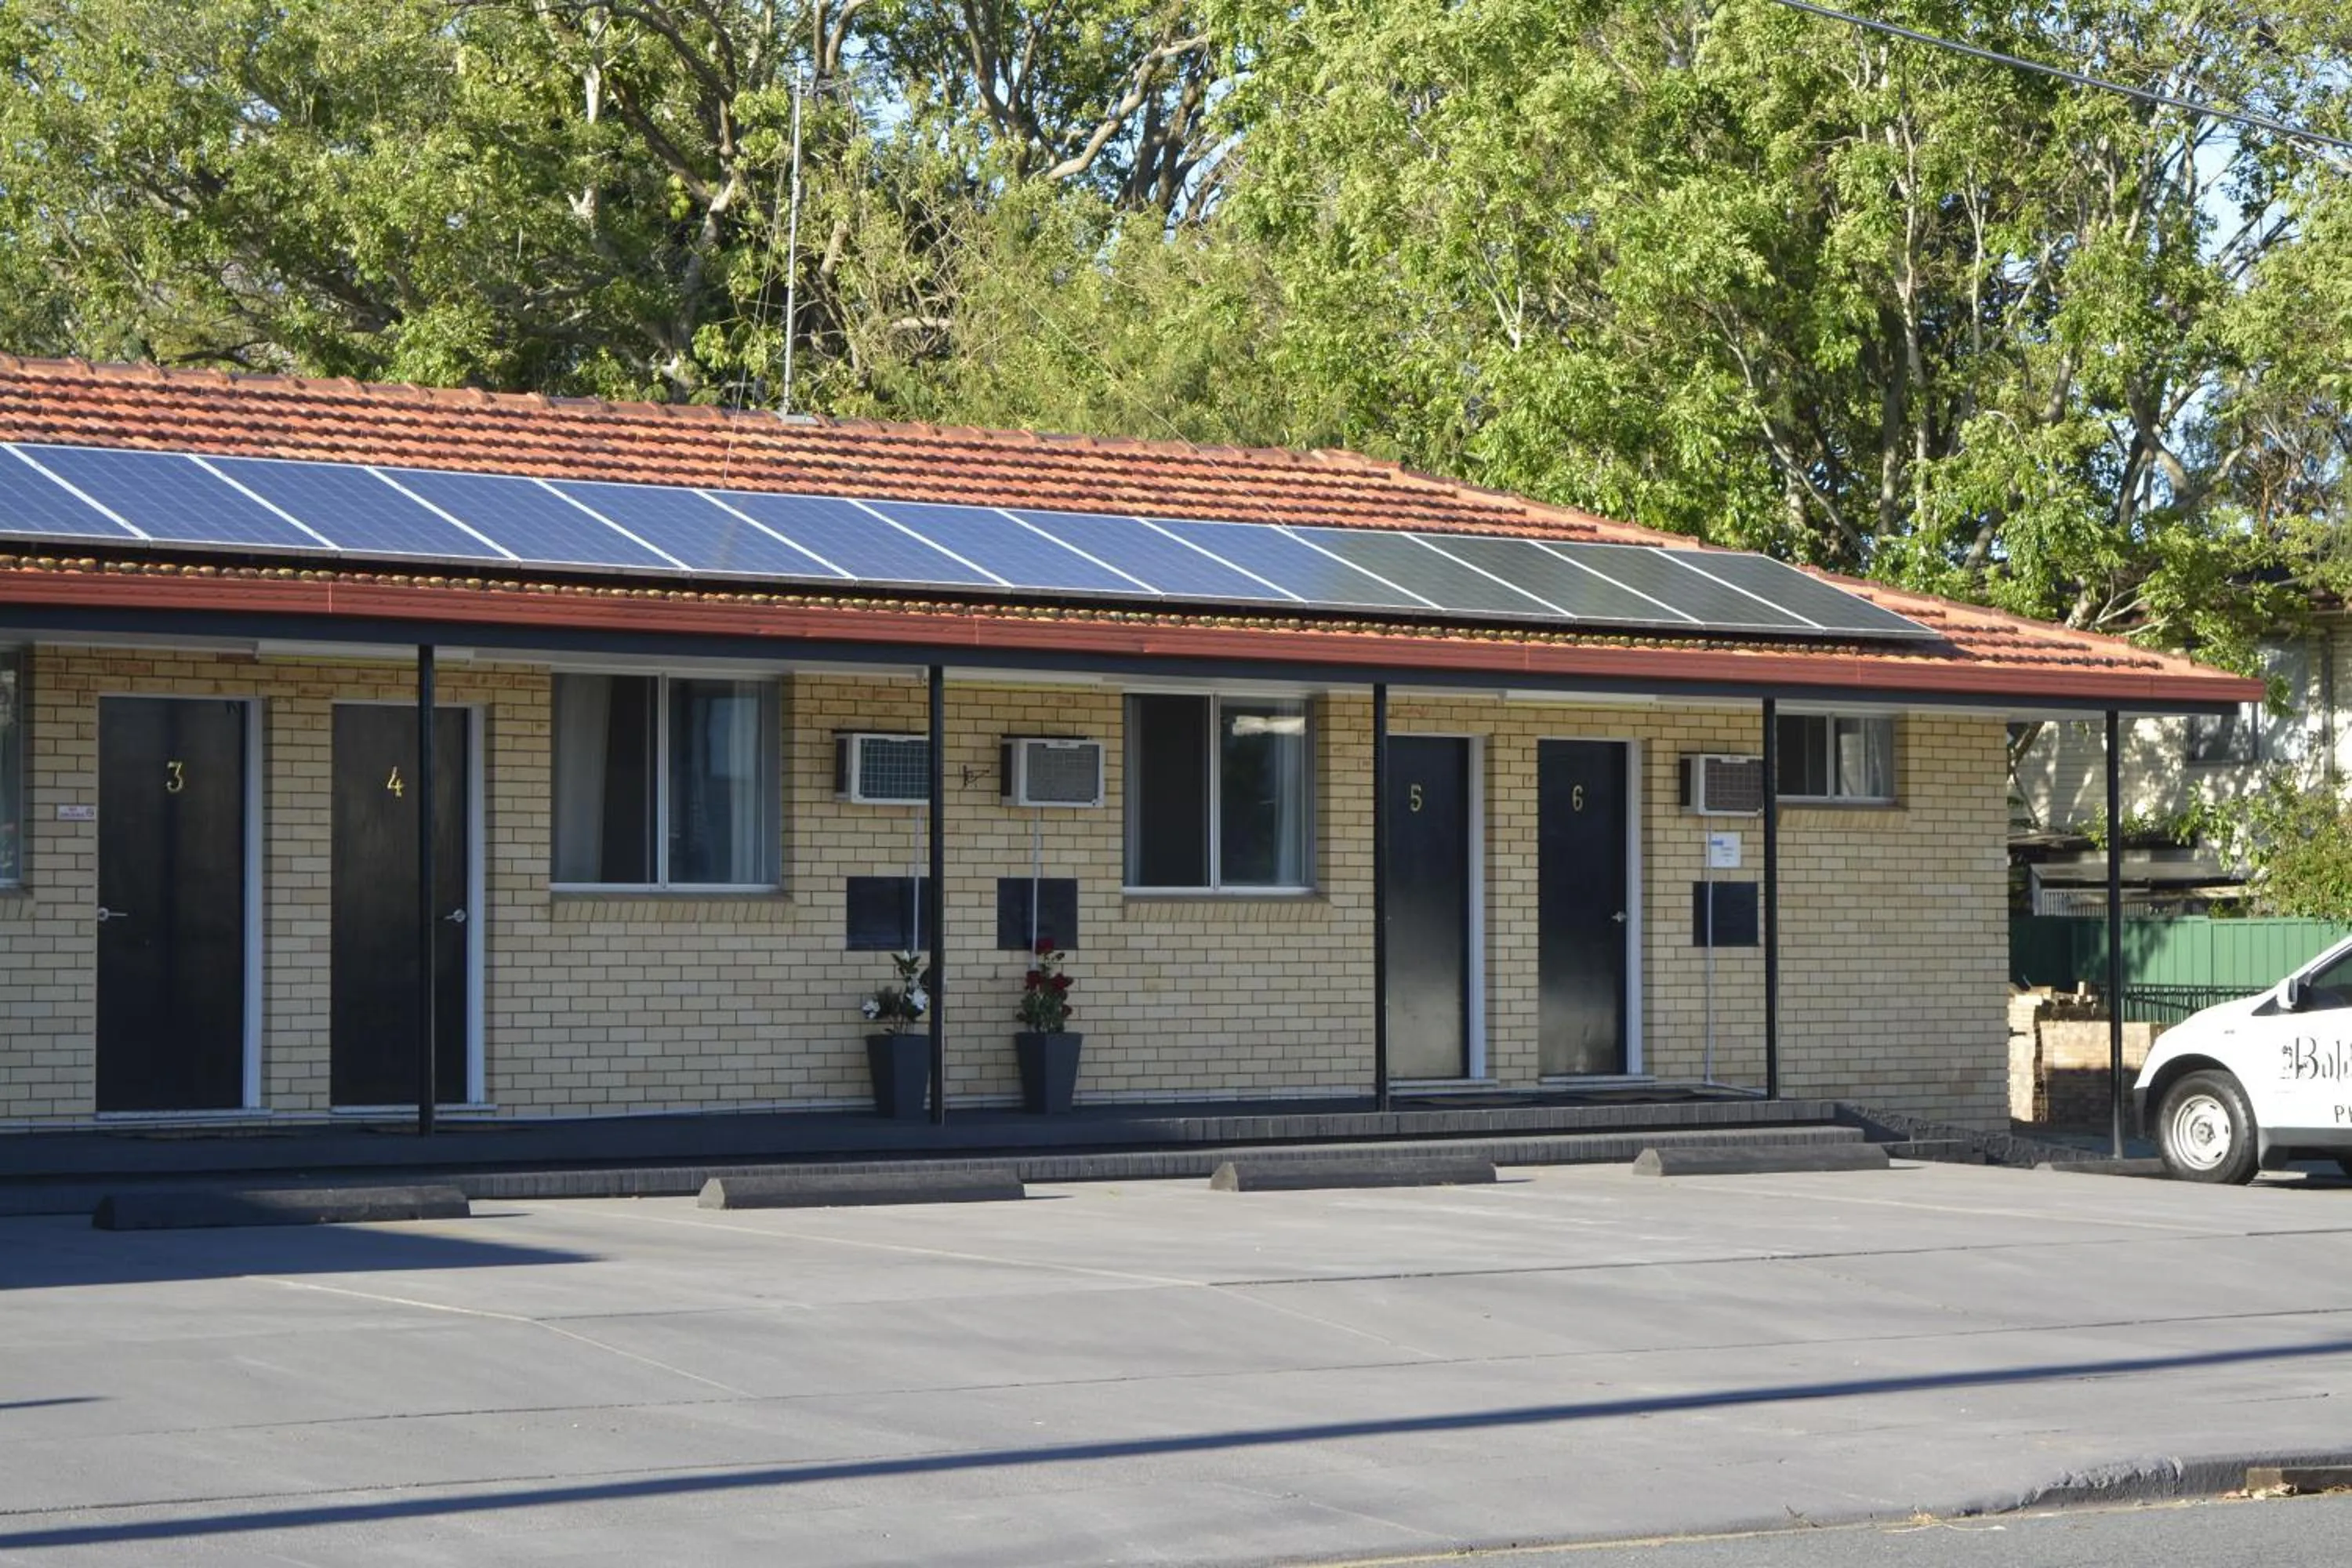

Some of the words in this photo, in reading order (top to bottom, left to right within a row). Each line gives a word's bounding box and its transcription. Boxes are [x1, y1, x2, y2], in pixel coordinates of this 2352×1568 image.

[167, 761, 183, 792] 3
[387, 766, 403, 797] 4
[1410, 784, 1422, 811] 5
[1573, 785, 1583, 811] 6
